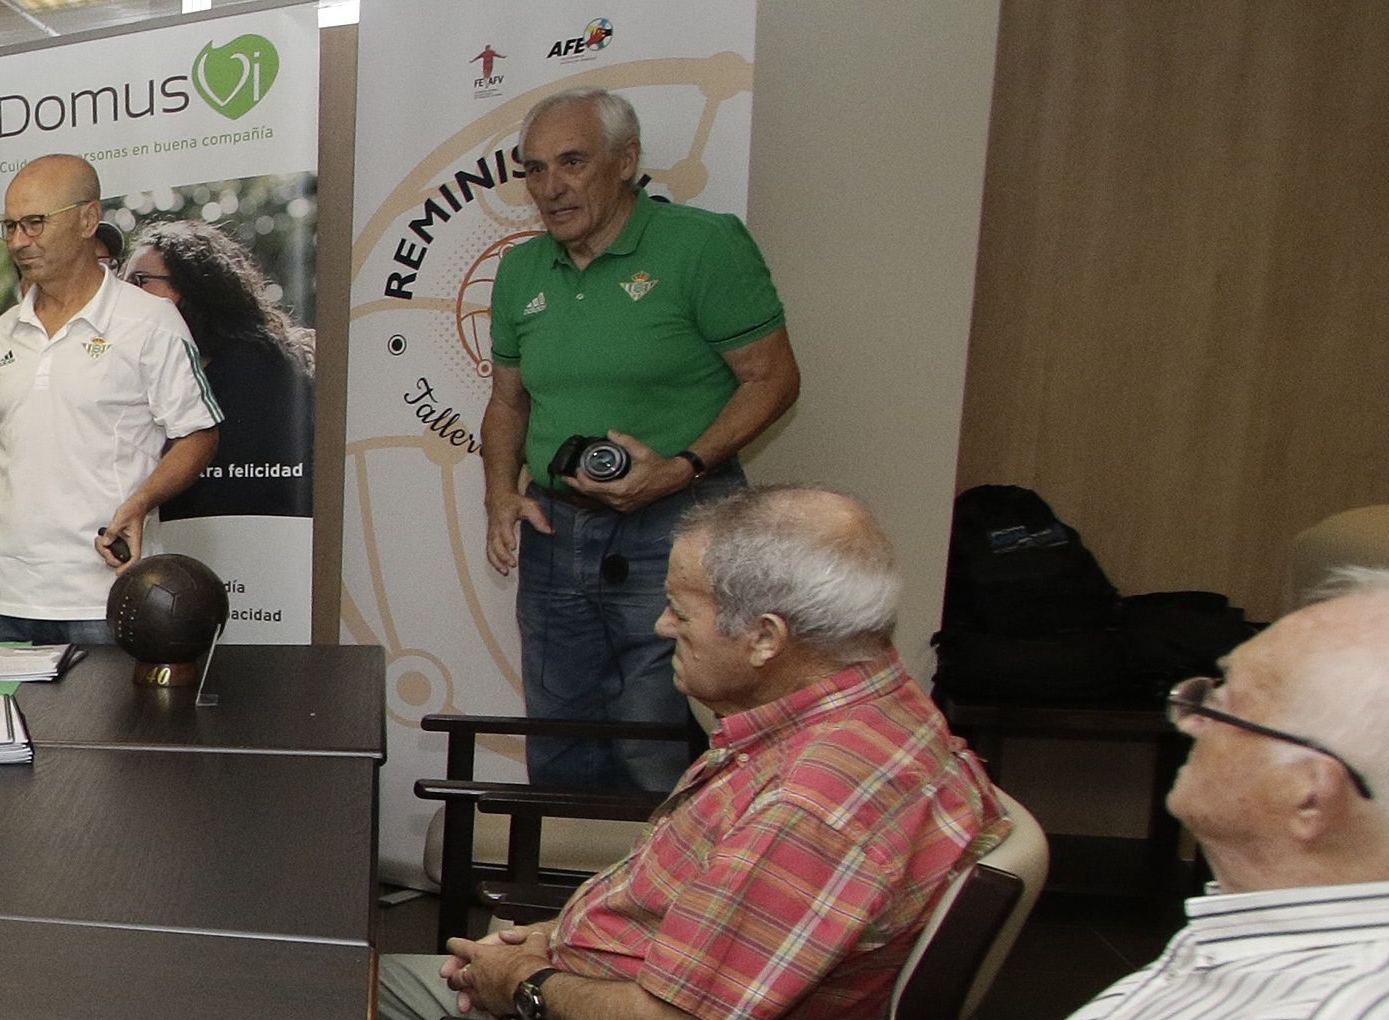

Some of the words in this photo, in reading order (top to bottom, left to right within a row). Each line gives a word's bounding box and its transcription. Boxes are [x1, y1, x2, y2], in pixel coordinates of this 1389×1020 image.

[547, 37, 586, 58] AFE
[132, 145, 149, 156] en
[154, 138, 197, 153] buena
[202, 126, 274, 147] compañía
[228, 462, 304, 478] felicidad
